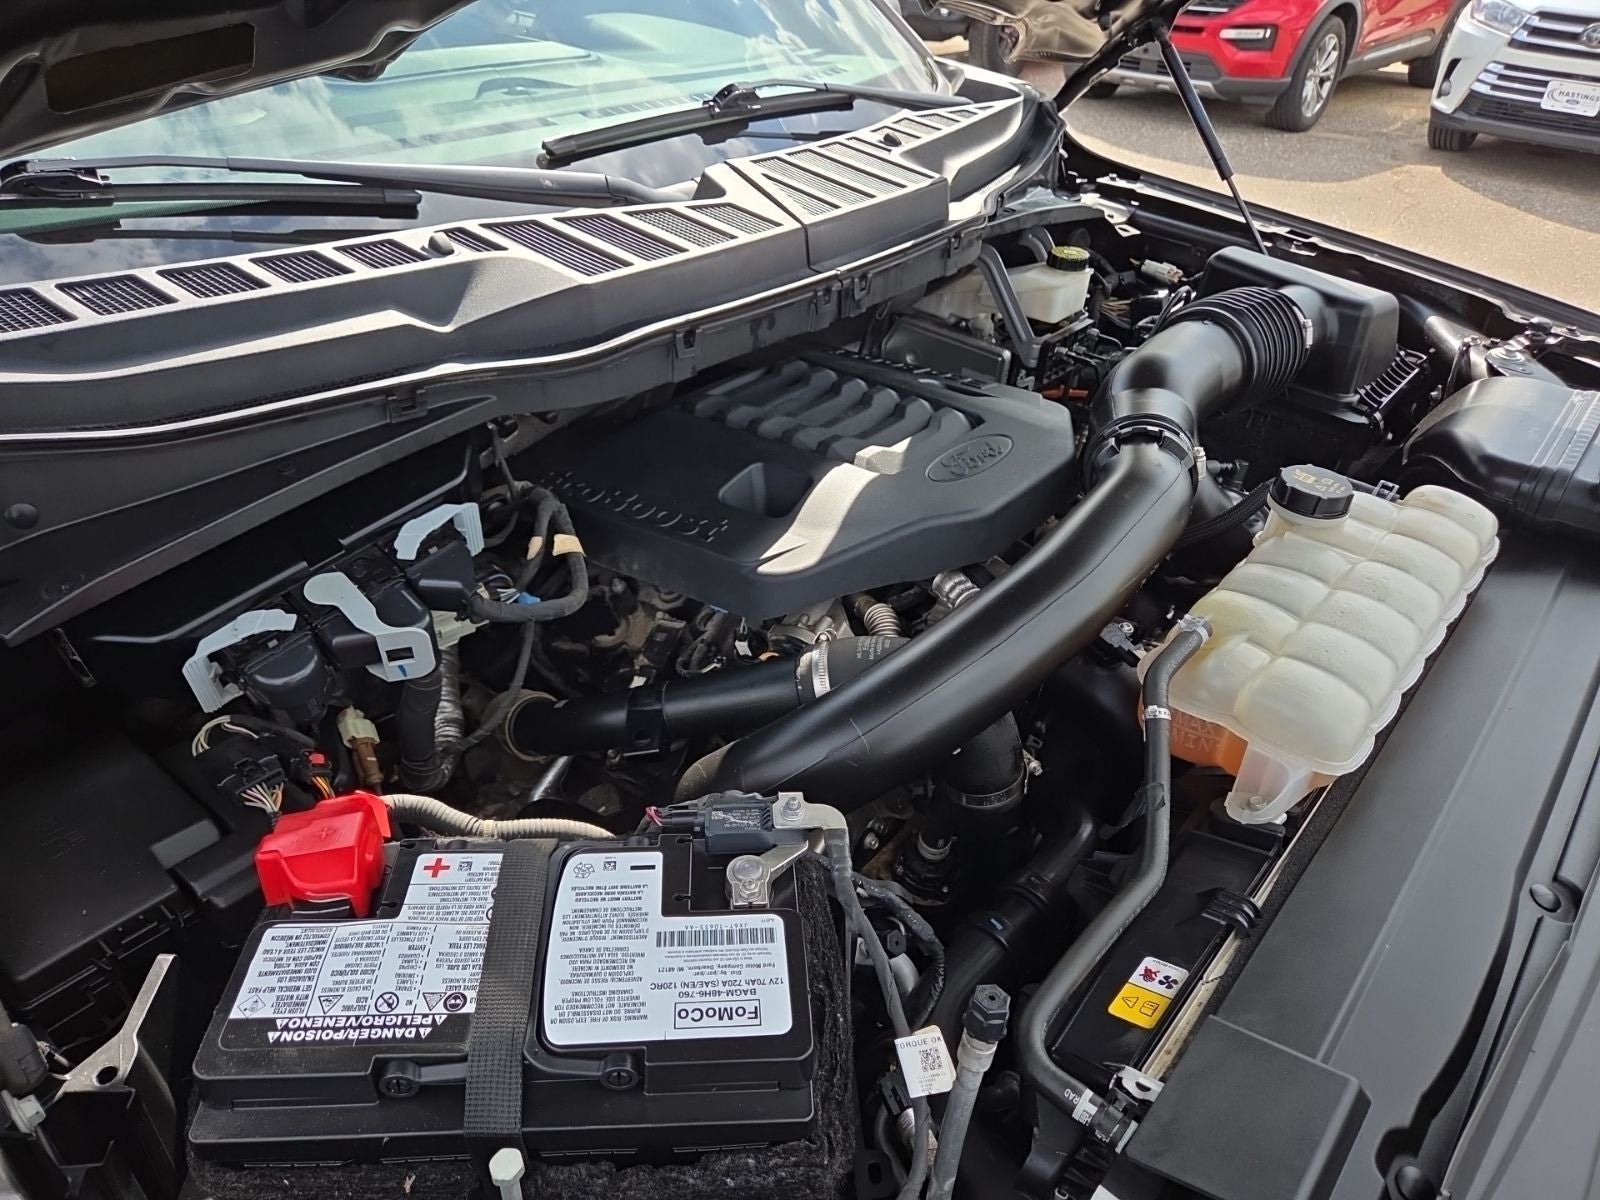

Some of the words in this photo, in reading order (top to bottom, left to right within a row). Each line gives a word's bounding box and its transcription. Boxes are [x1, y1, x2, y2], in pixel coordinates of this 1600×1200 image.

[940, 441, 1003, 477] Ford
[650, 982, 677, 990] 120RC
[680, 979, 719, 988] (SAE/EN)
[679, 988, 756, 998] BAGM-48H6-760
[288, 1014, 433, 1028] PELIGRO/VENENO
[678, 1006, 758, 1022] FoMoCo
[280, 1028, 416, 1042] DANGER/POISON
[1064, 1088, 1081, 1104] RAD
